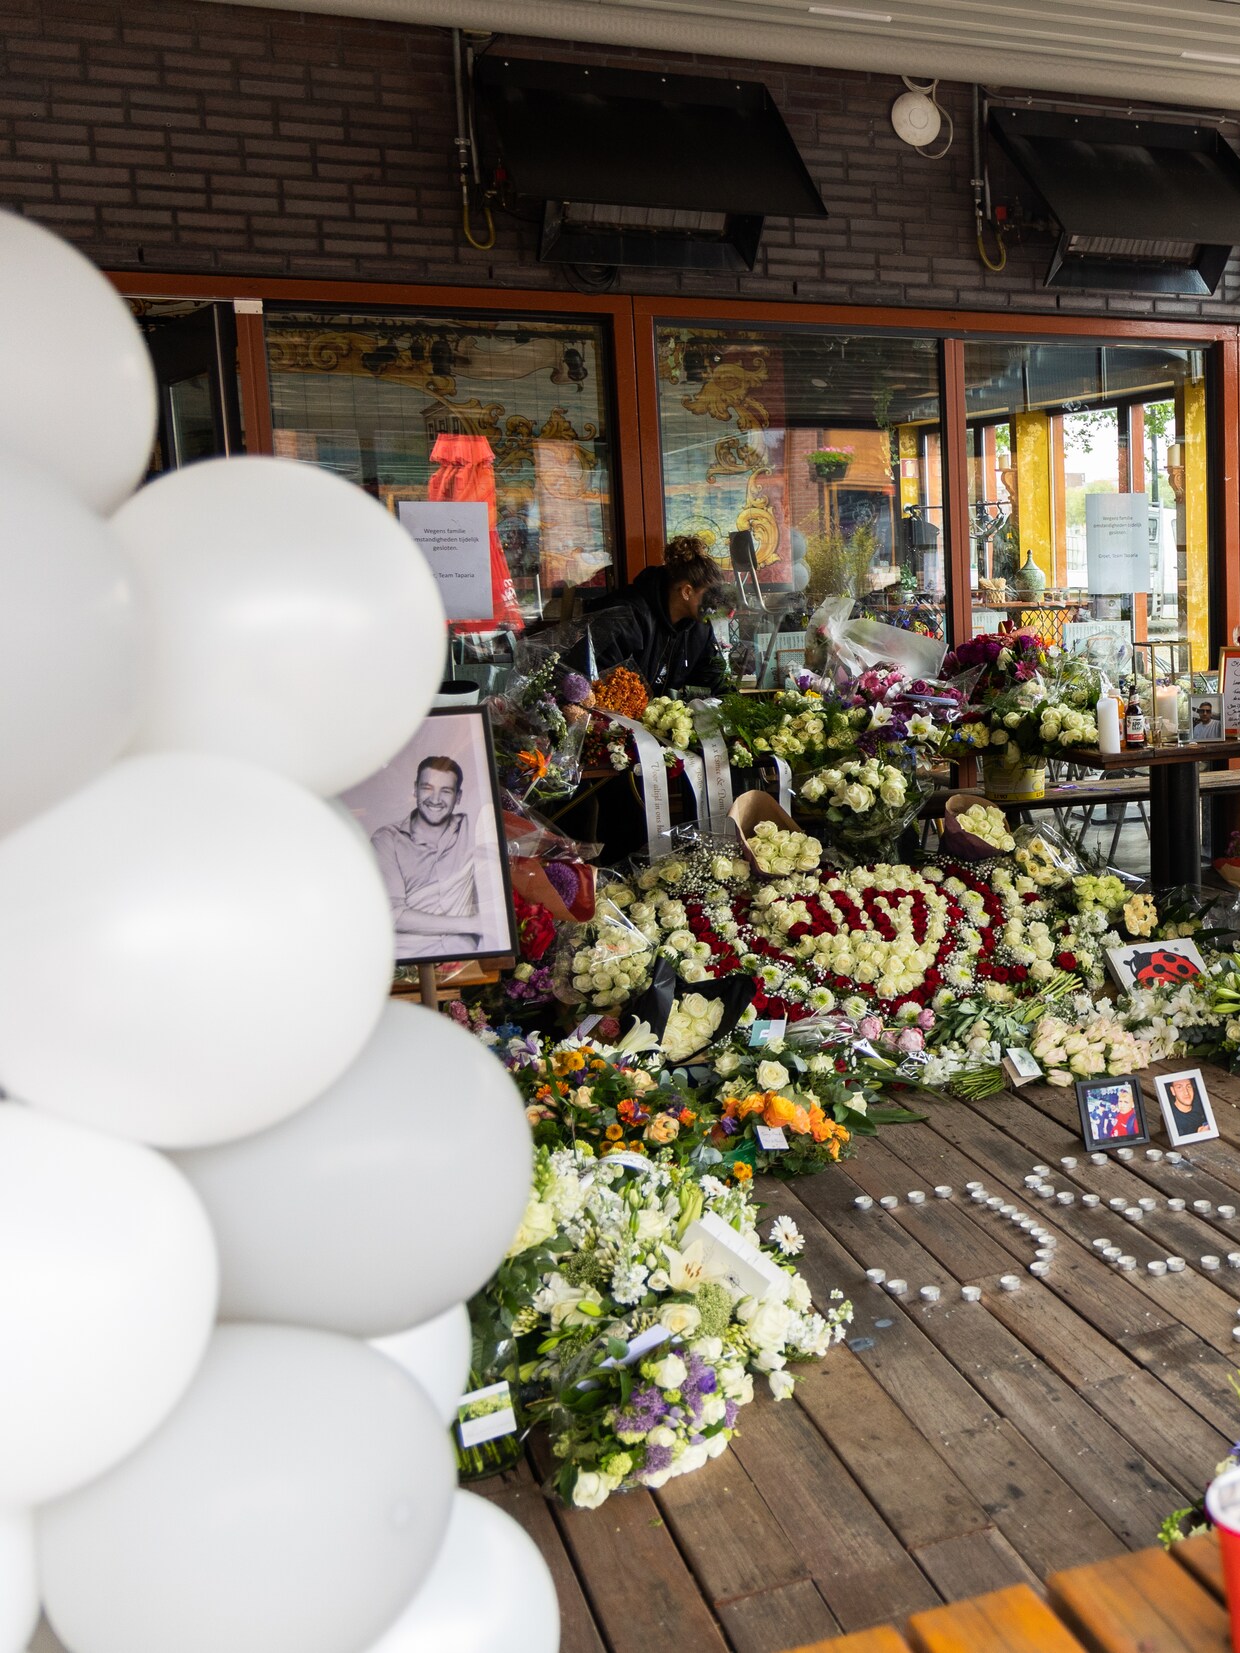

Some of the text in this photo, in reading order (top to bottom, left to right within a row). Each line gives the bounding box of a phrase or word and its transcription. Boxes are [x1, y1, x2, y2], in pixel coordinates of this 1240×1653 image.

[413, 536, 480, 544] mstandigheden tijdelijk
[455, 572, 475, 580] Taparia
[653, 782, 662, 804] altijd
